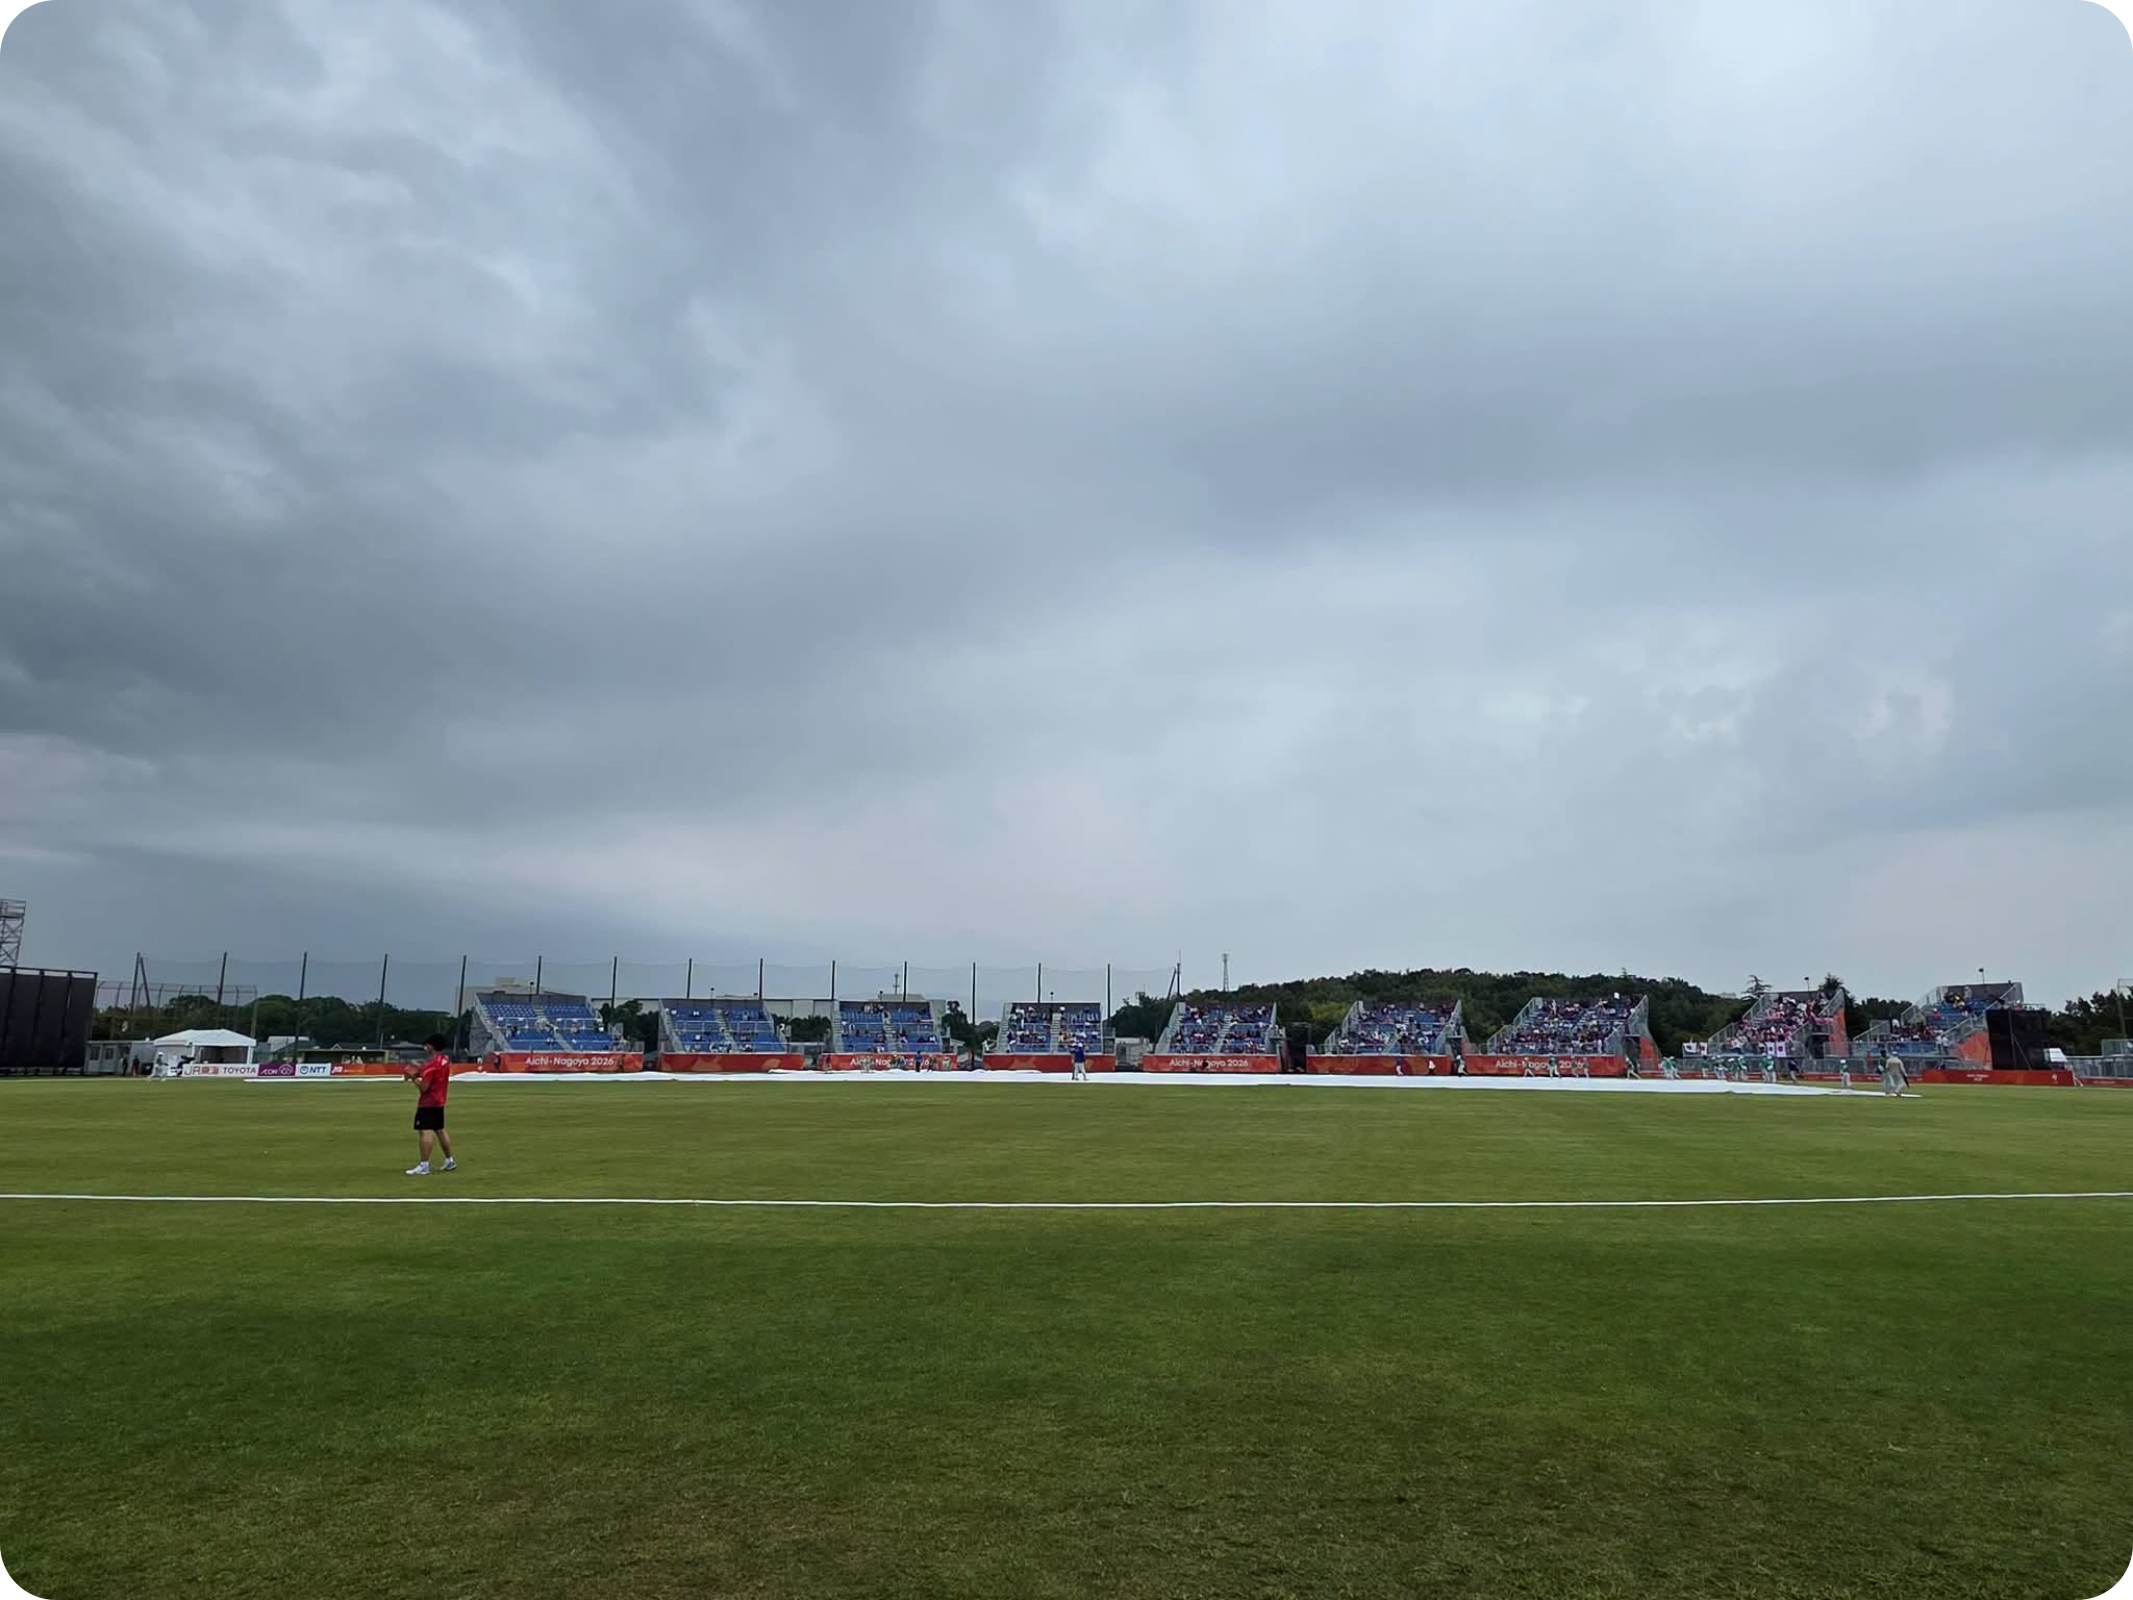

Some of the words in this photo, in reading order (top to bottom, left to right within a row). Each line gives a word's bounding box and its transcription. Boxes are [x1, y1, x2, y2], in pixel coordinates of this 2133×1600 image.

[590, 1057, 614, 1066] 2026
[1559, 1060, 1583, 1069] 206
[223, 1066, 257, 1075] TOYOTA
